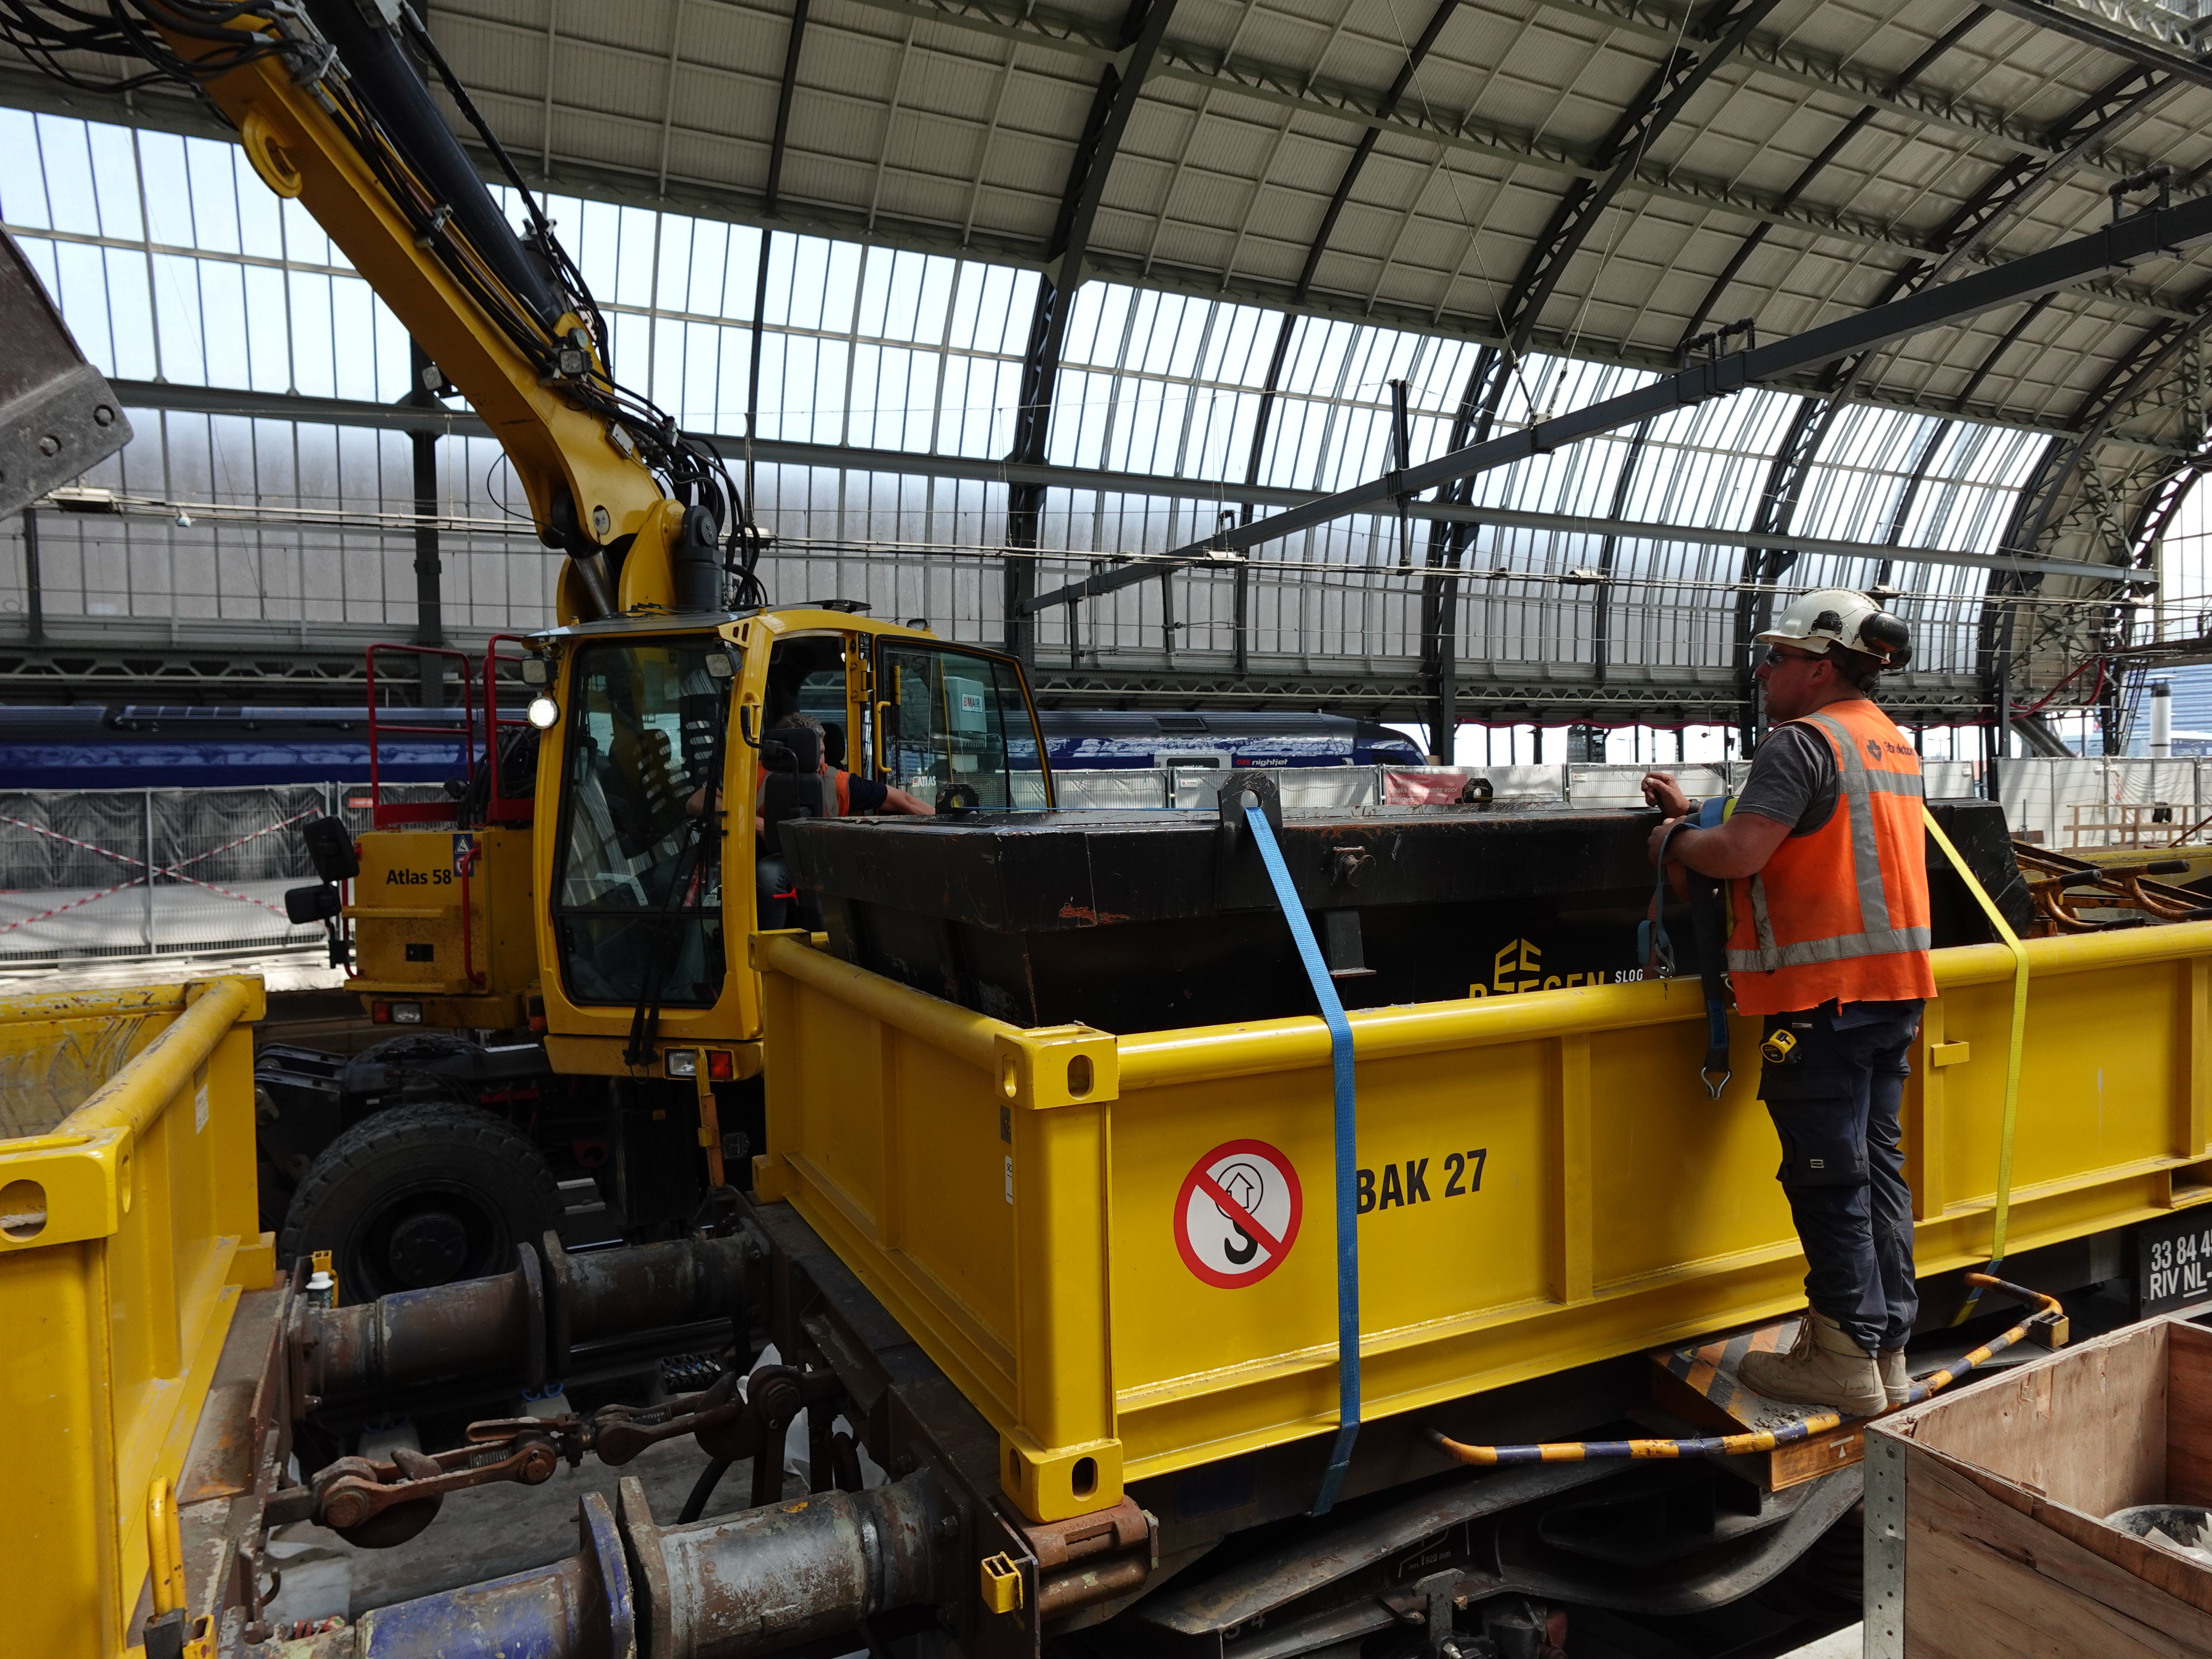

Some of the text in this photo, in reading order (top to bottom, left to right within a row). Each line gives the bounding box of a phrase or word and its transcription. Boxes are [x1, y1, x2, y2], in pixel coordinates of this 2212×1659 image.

[963, 697, 980, 708] BMAIR
[1252, 759, 1288, 767] nightjet
[387, 869, 452, 885] Atlas 58
[1357, 1148, 1487, 1215] BAK 27
[2152, 1229, 2212, 1271] 33 84 4
[2150, 1267, 2179, 1300] RIV
[1425, 1553, 1438, 1564] 920
[1439, 1551, 1451, 1560] mm
